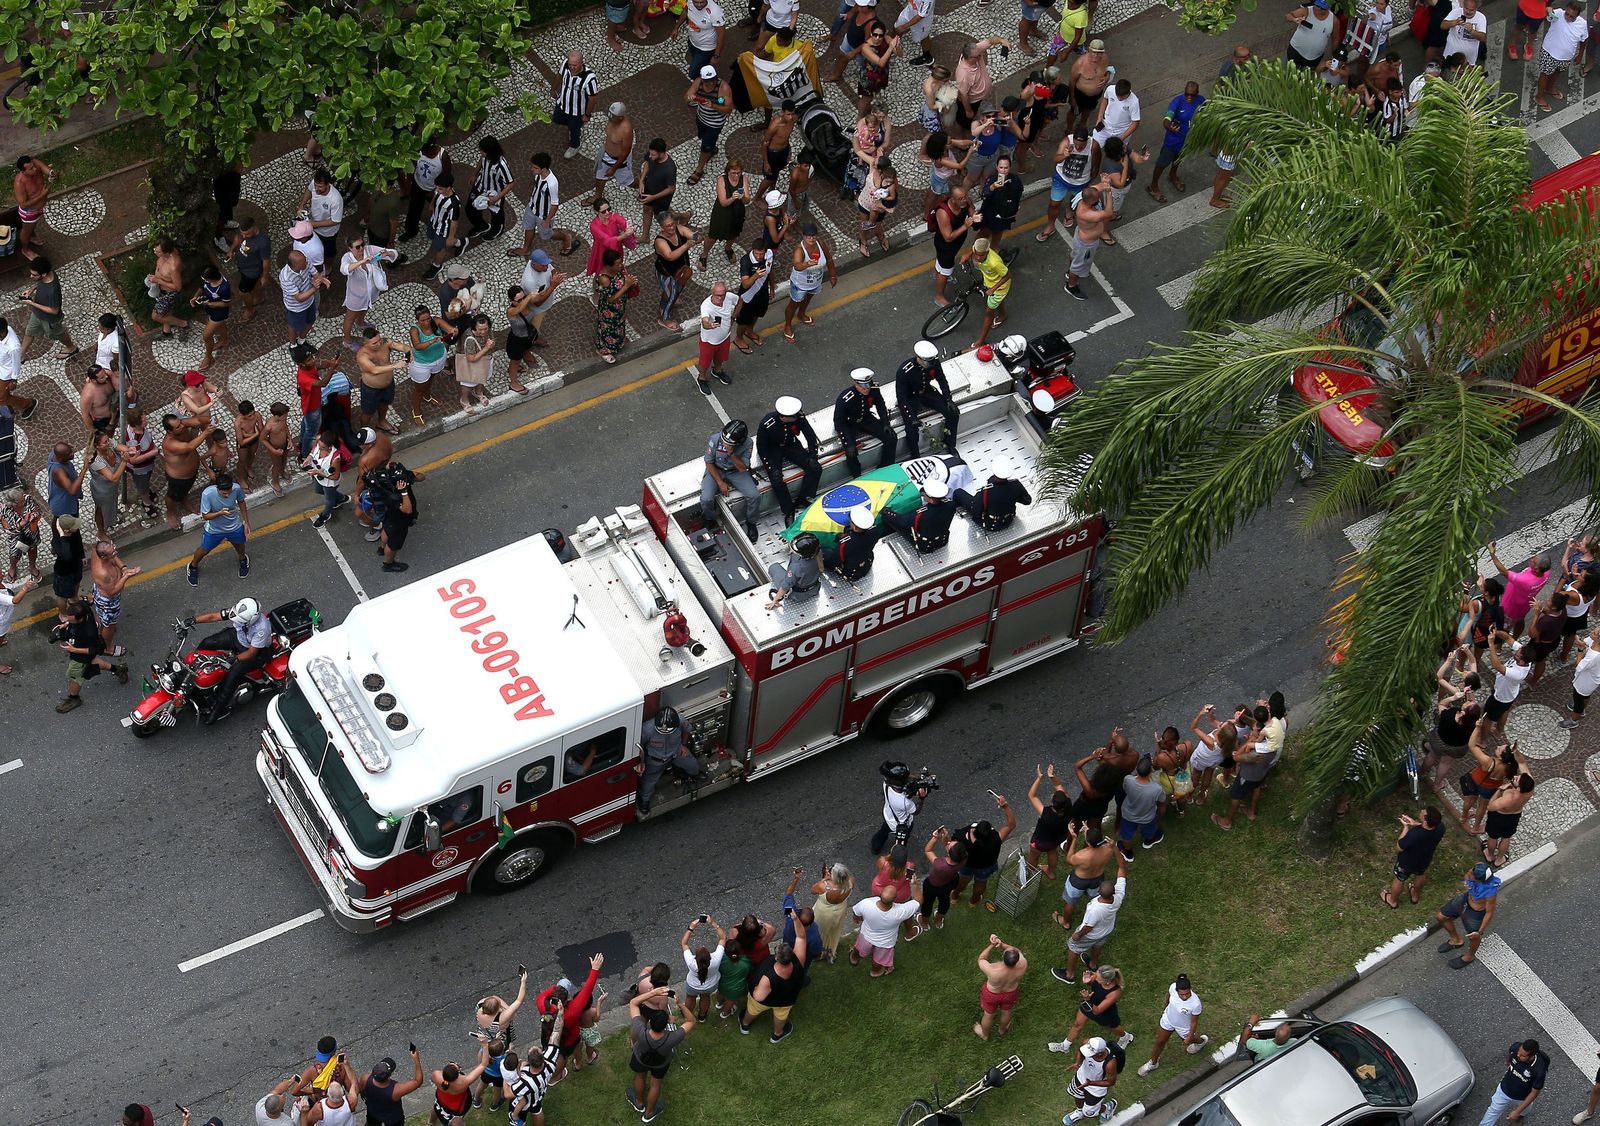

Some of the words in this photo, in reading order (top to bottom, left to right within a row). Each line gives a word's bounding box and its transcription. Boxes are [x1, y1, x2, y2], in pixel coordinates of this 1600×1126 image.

[437, 578, 555, 721] AB-06105
[771, 565, 996, 671] BOMBEIROS
[1056, 529, 1089, 551] 193
[497, 779, 512, 794] 6
